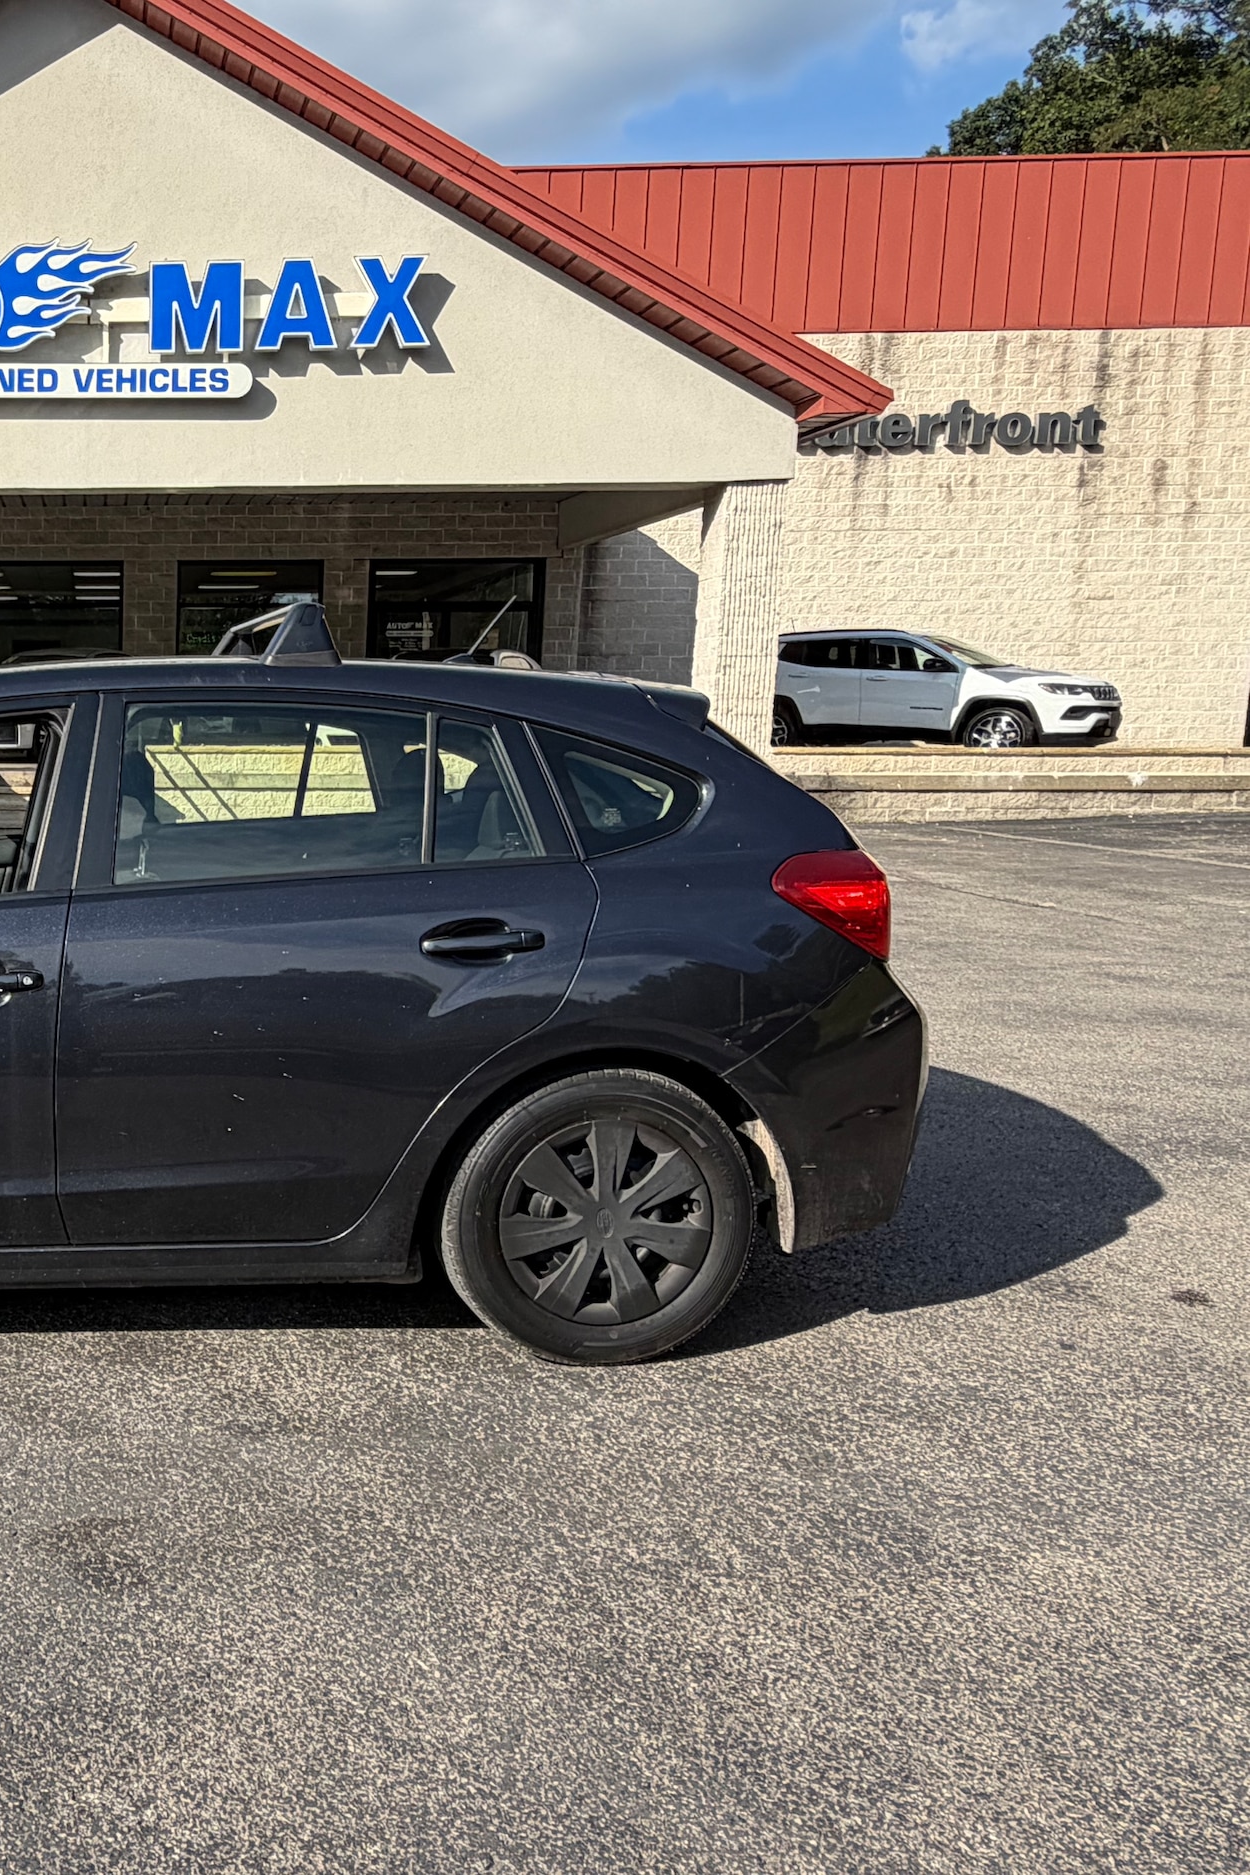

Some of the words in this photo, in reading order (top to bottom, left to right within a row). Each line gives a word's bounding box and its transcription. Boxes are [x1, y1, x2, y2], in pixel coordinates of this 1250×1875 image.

[150, 255, 432, 352] MAX
[74, 369, 229, 393] VEHICLES
[812, 400, 1104, 447] aterfront
